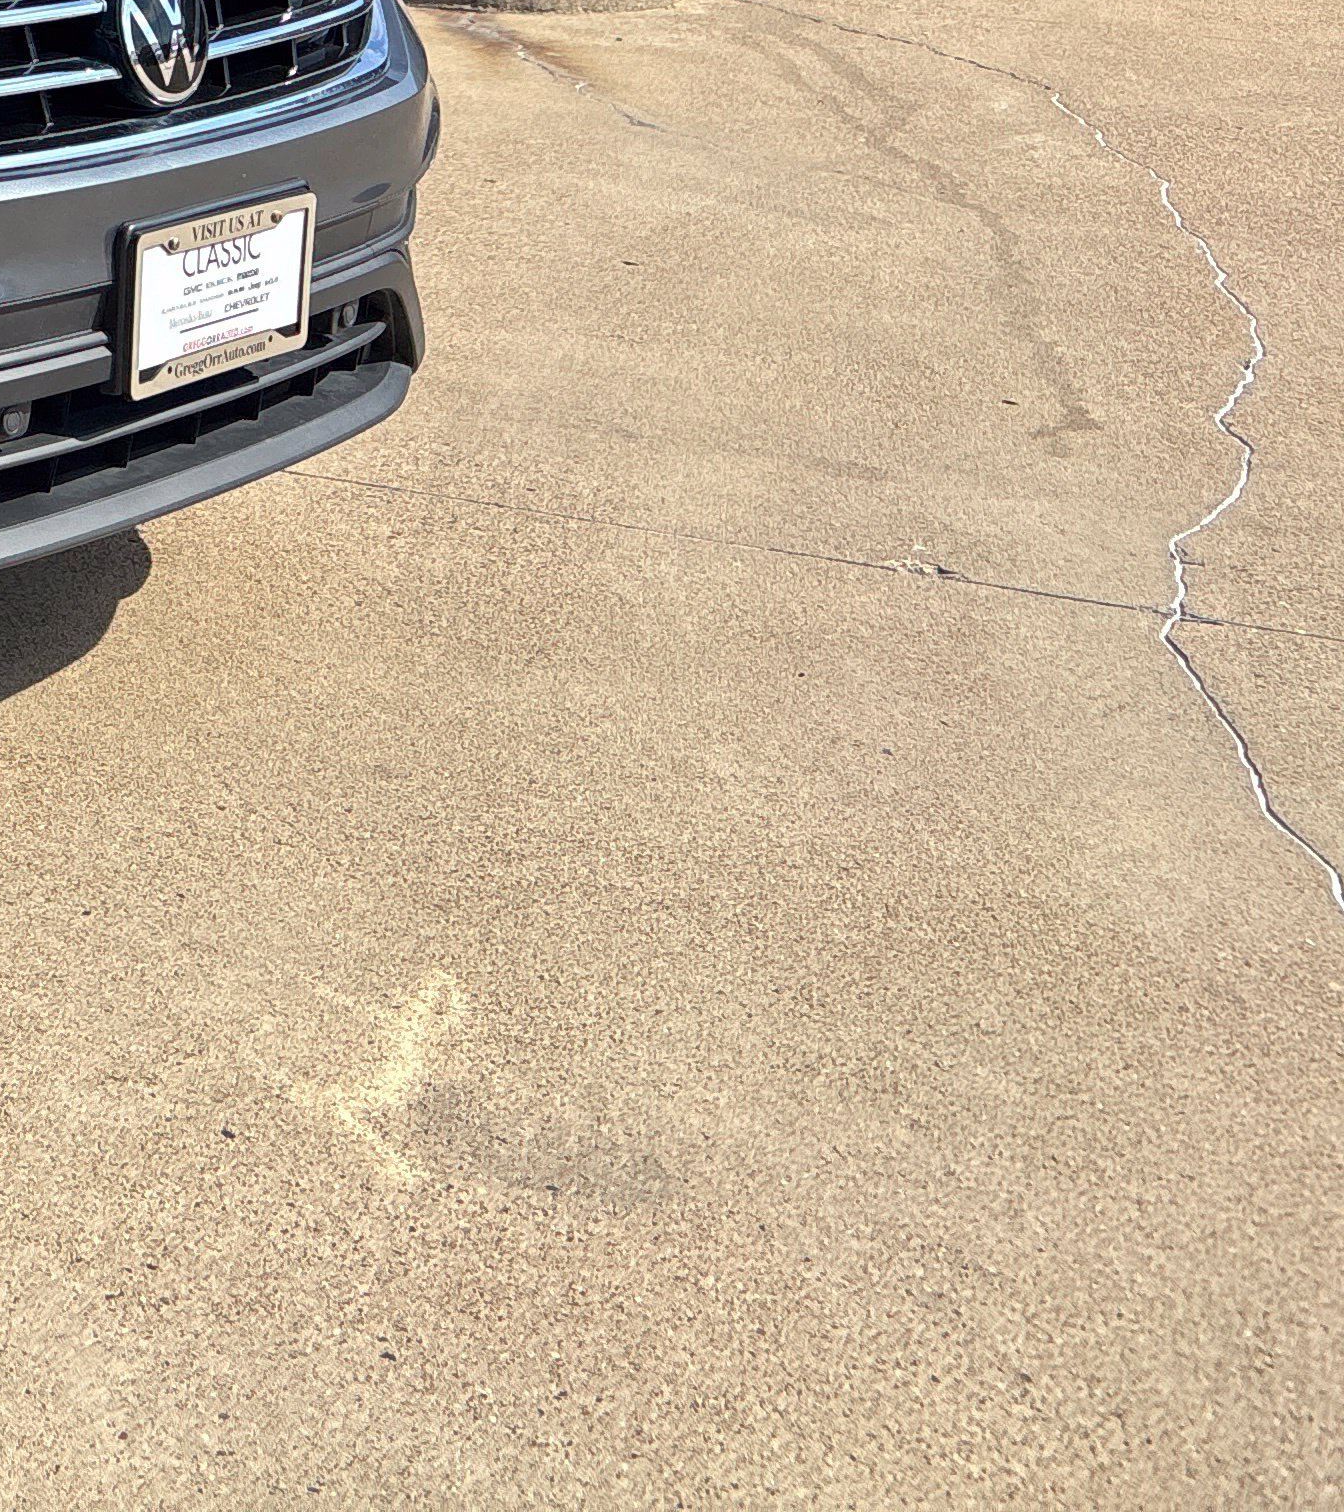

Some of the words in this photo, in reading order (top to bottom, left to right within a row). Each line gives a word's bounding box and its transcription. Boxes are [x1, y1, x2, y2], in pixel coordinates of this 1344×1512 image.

[191, 219, 226, 242] VISIT
[229, 214, 245, 234] US
[247, 210, 264, 229] AT
[182, 234, 261, 277] CLASSIC
[174, 341, 266, 379] GreggOrrAuto.com
